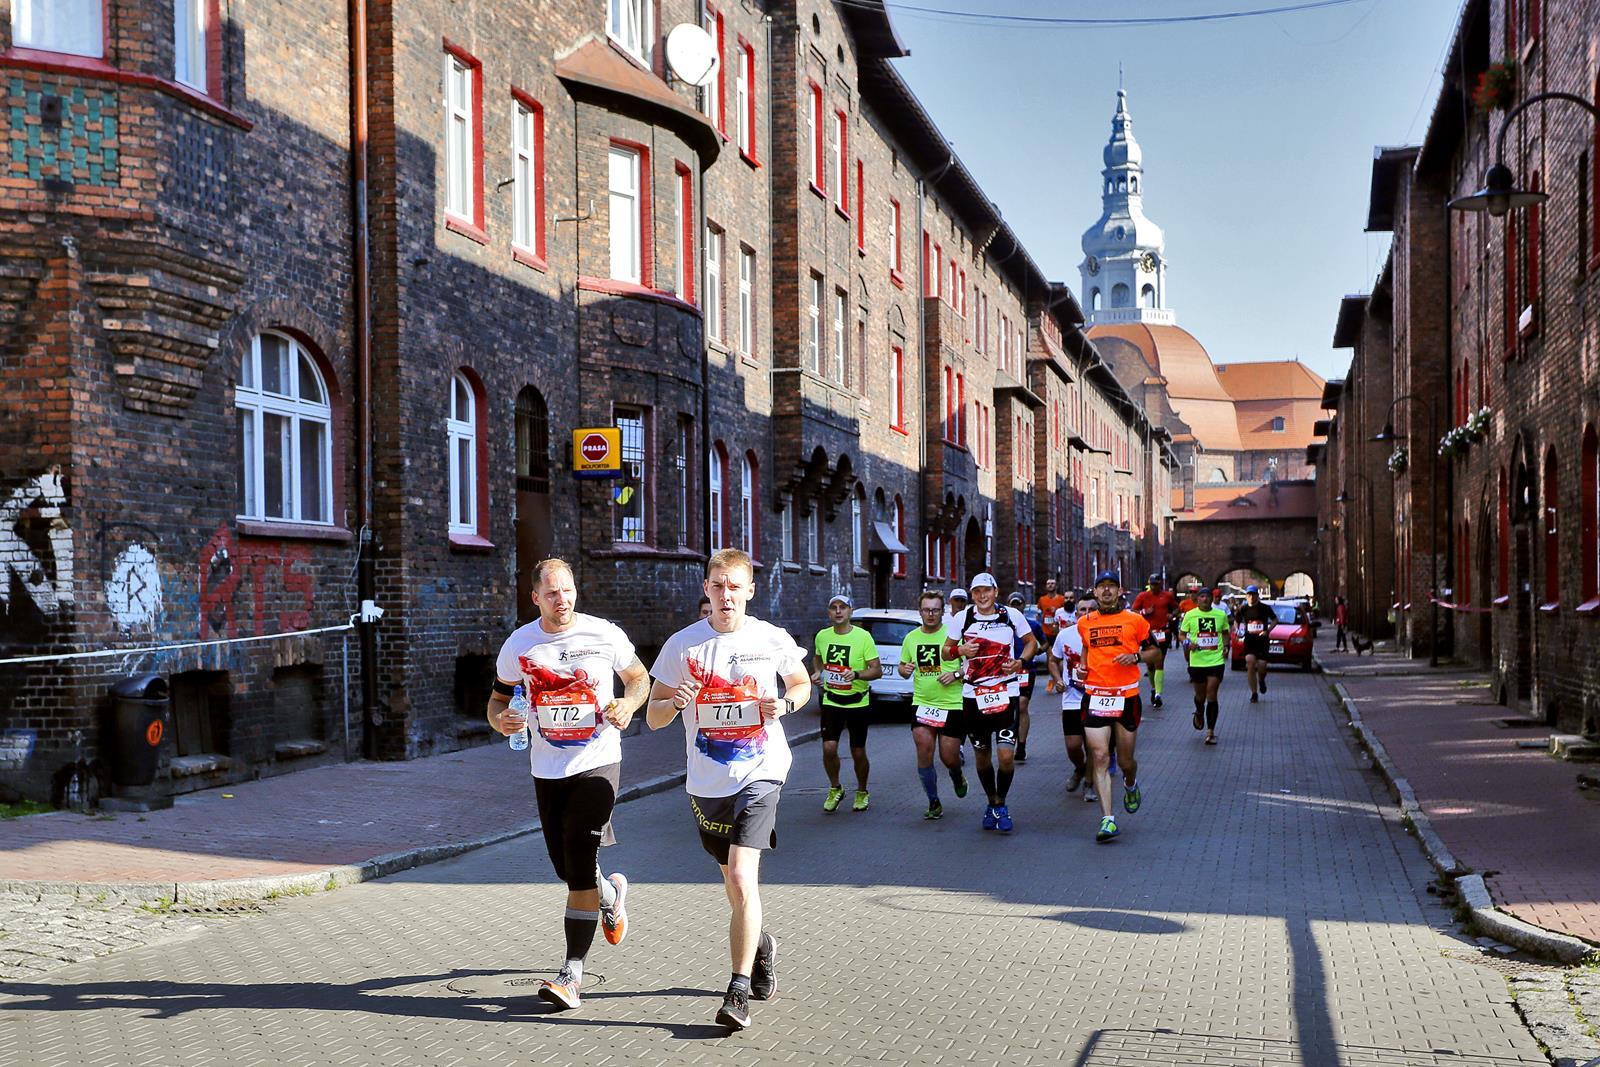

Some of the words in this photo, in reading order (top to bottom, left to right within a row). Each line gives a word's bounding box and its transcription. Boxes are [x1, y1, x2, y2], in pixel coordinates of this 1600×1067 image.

[983, 694, 1000, 704] 654
[1098, 698, 1116, 707] 427
[550, 706, 580, 722] 772
[712, 704, 743, 720] 771
[924, 707, 940, 718] 245
[690, 796, 733, 834] ROSSFIT
